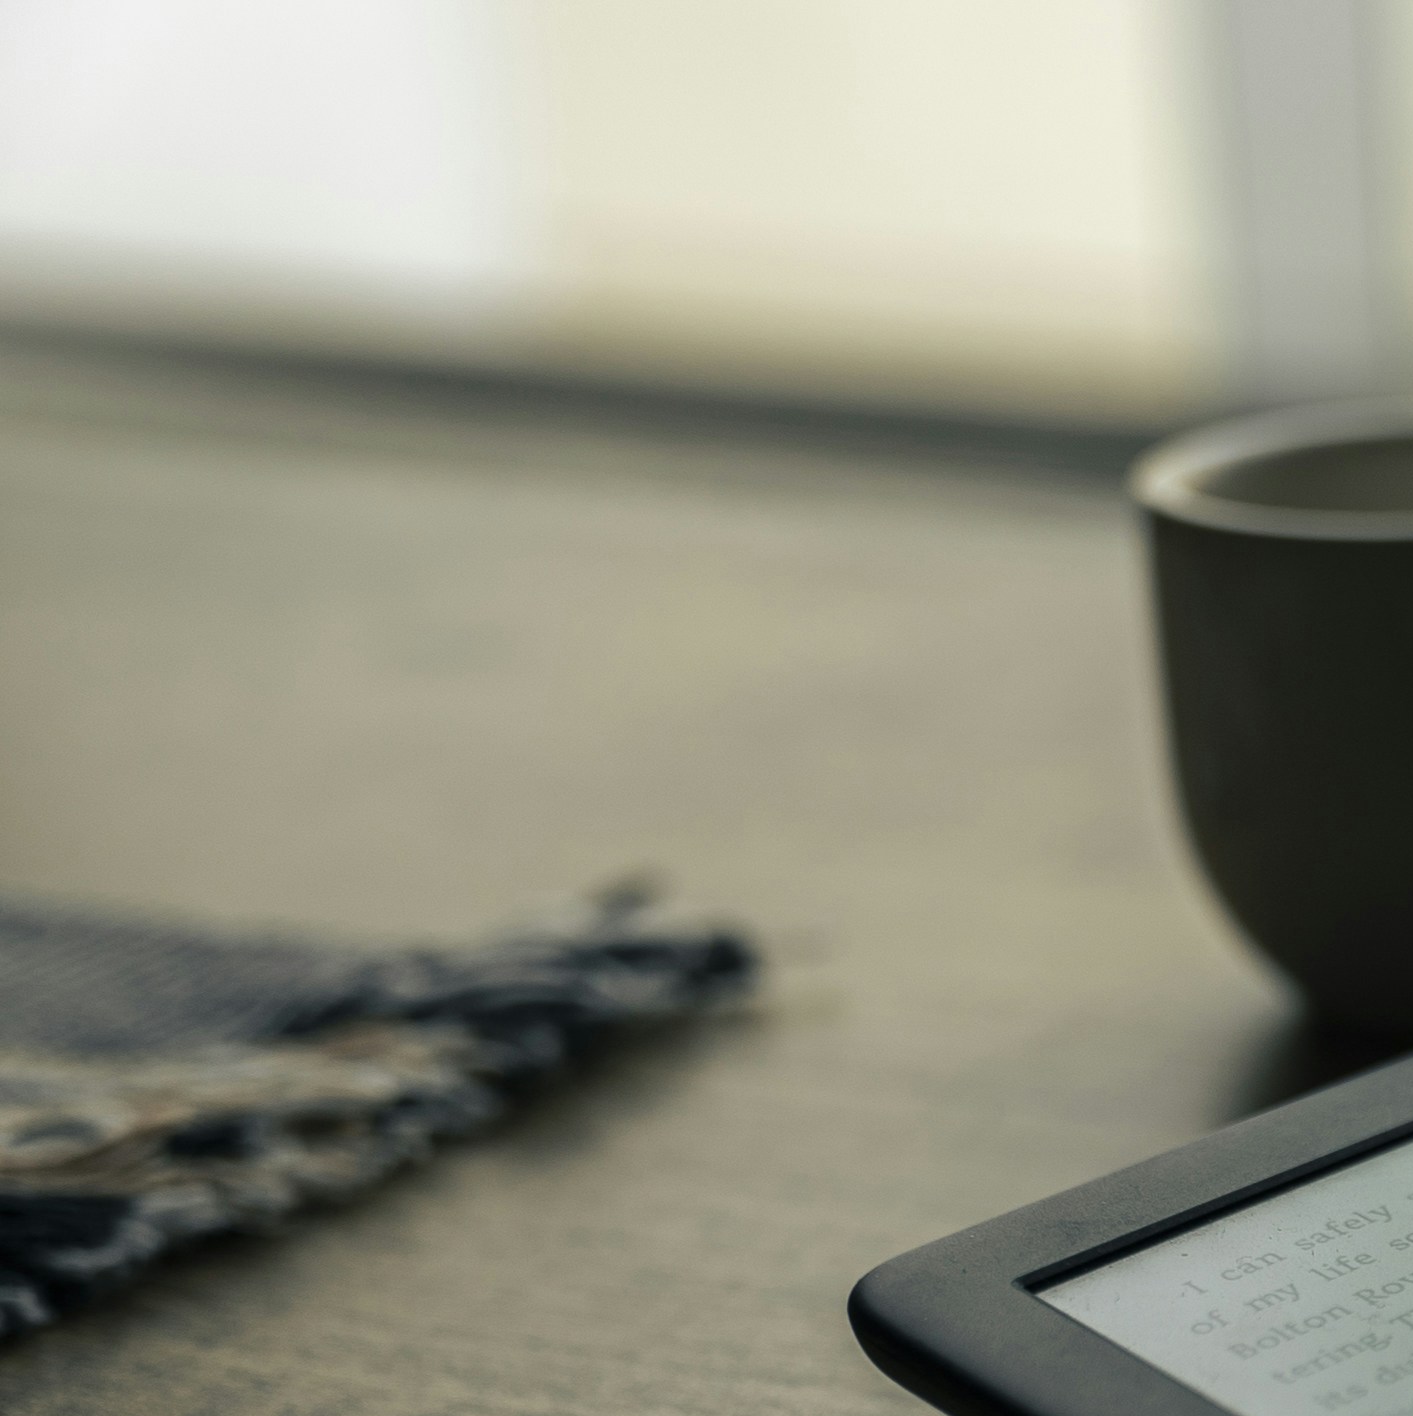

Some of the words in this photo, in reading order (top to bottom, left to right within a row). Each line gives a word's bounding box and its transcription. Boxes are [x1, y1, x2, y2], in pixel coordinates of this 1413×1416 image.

[1181, 1279, 1209, 1294] I
[1221, 1252, 1287, 1280] can
[1294, 1204, 1391, 1250] safely
[1190, 1308, 1231, 1333] of
[1243, 1282, 1299, 1311] my
[1307, 1253, 1376, 1281] life
[1224, 1306, 1353, 1360] Bolton
[1271, 1332, 1392, 1383] tering.
[1311, 1383, 1369, 1411] its
